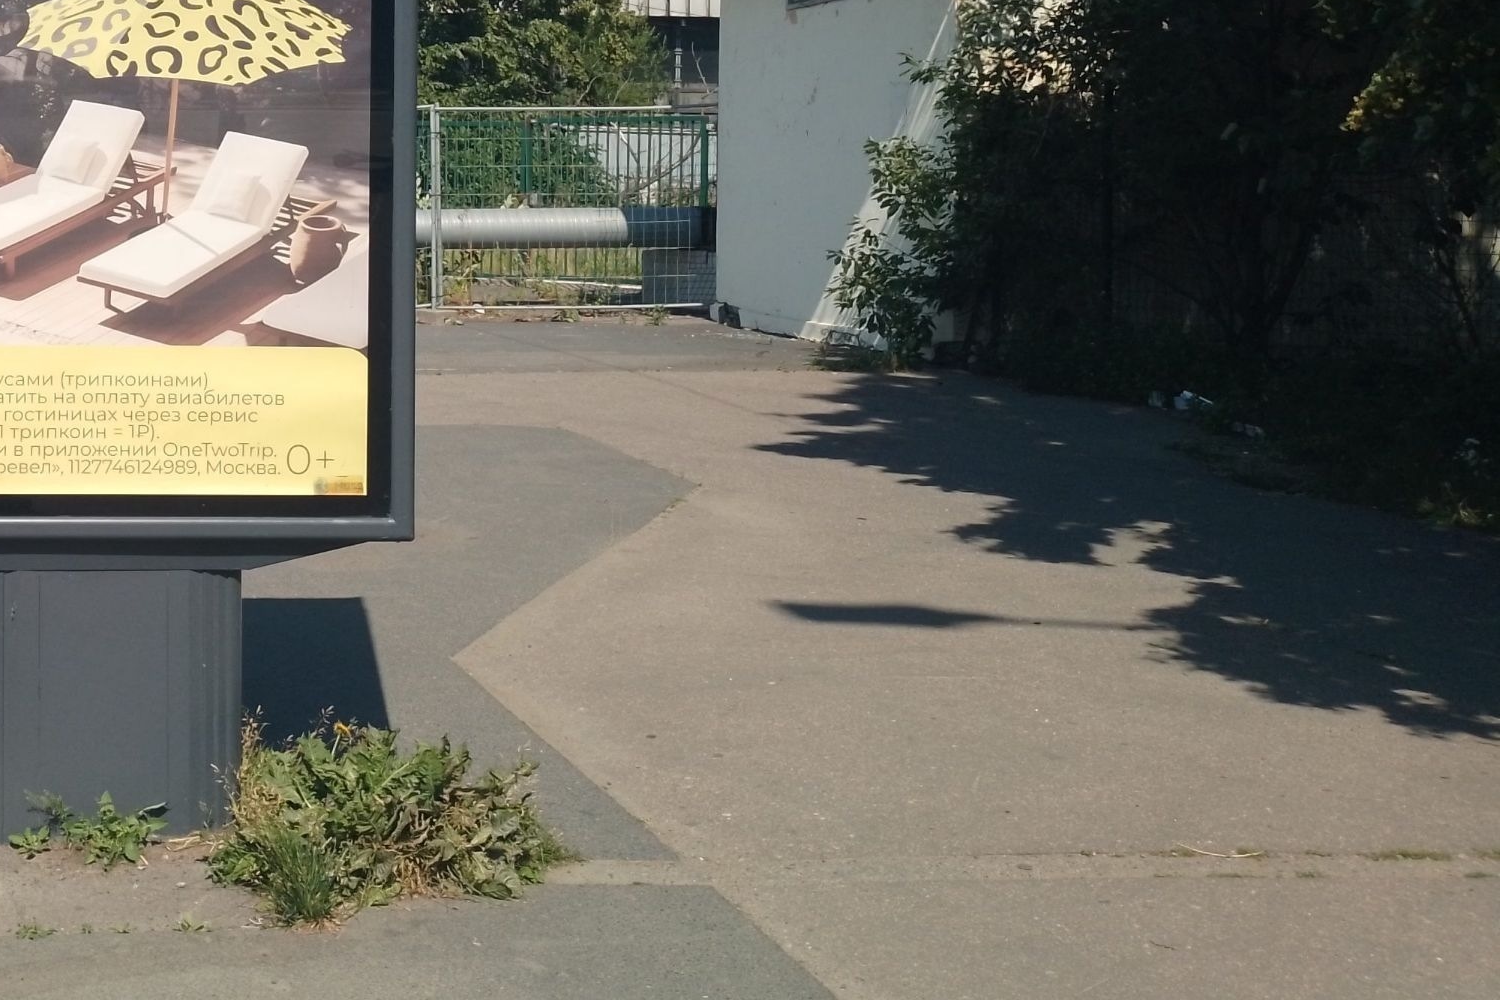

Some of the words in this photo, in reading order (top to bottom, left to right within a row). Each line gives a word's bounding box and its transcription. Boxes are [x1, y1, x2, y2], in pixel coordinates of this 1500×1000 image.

[60, 370, 208, 391] (трипкоинами)
[54, 392, 76, 404] на
[82, 391, 150, 408] оплату
[156, 388, 284, 406] авиабилетов
[4, 409, 118, 424] гостиницах
[123, 409, 181, 424] через
[185, 409, 258, 425] сервис
[8, 425, 108, 440] трипкоин
[12, 444, 25, 456] в
[28, 442, 156, 459] приложении
[162, 441, 277, 460] OneTwoTrip.
[287, 444, 335, 475] 0+
[68, 459, 200, 477] 1127746124989,
[205, 459, 283, 476] Москва.
